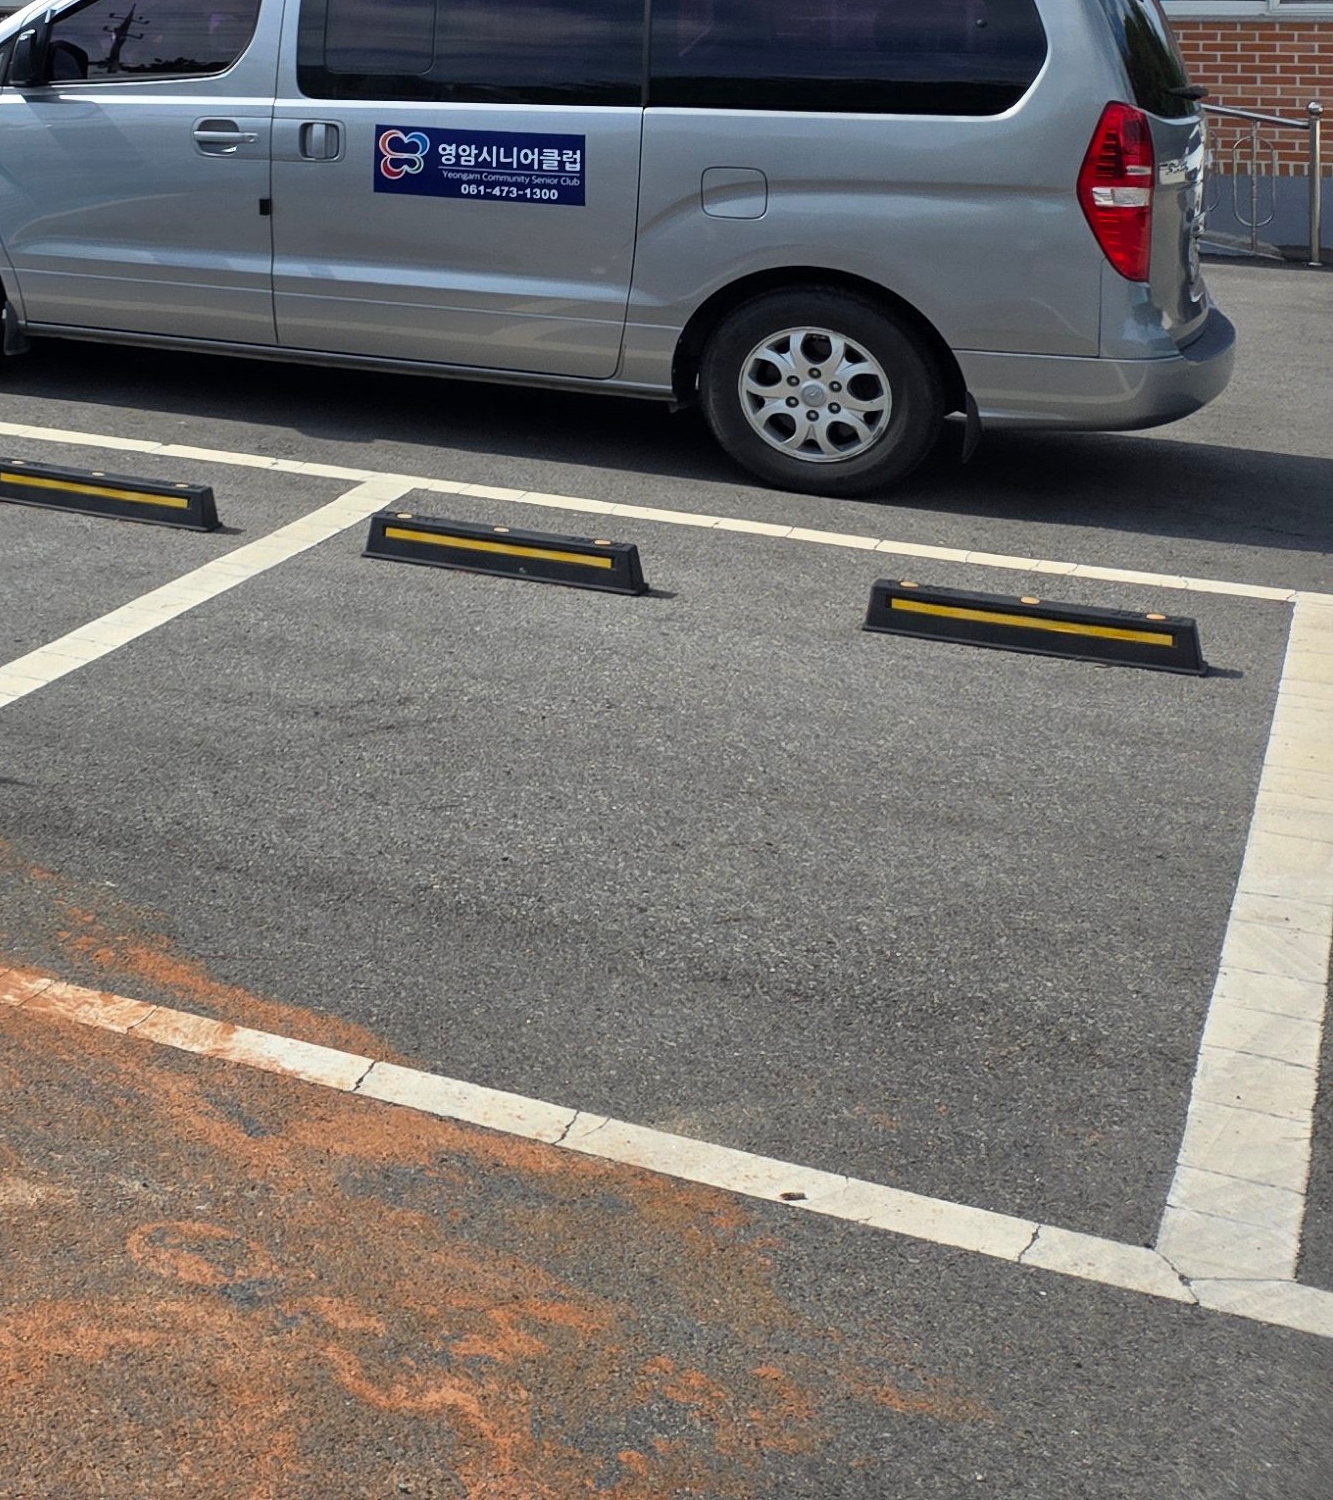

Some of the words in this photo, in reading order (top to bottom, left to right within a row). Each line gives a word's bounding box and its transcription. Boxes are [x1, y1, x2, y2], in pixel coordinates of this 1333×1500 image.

[438, 143, 581, 172] 영암시니어클럽
[442, 169, 481, 182] Yeongam
[482, 172, 530, 185] Community
[531, 175, 559, 186] Senior
[560, 176, 580, 187] Club
[461, 184, 559, 200] 061-473-1300
